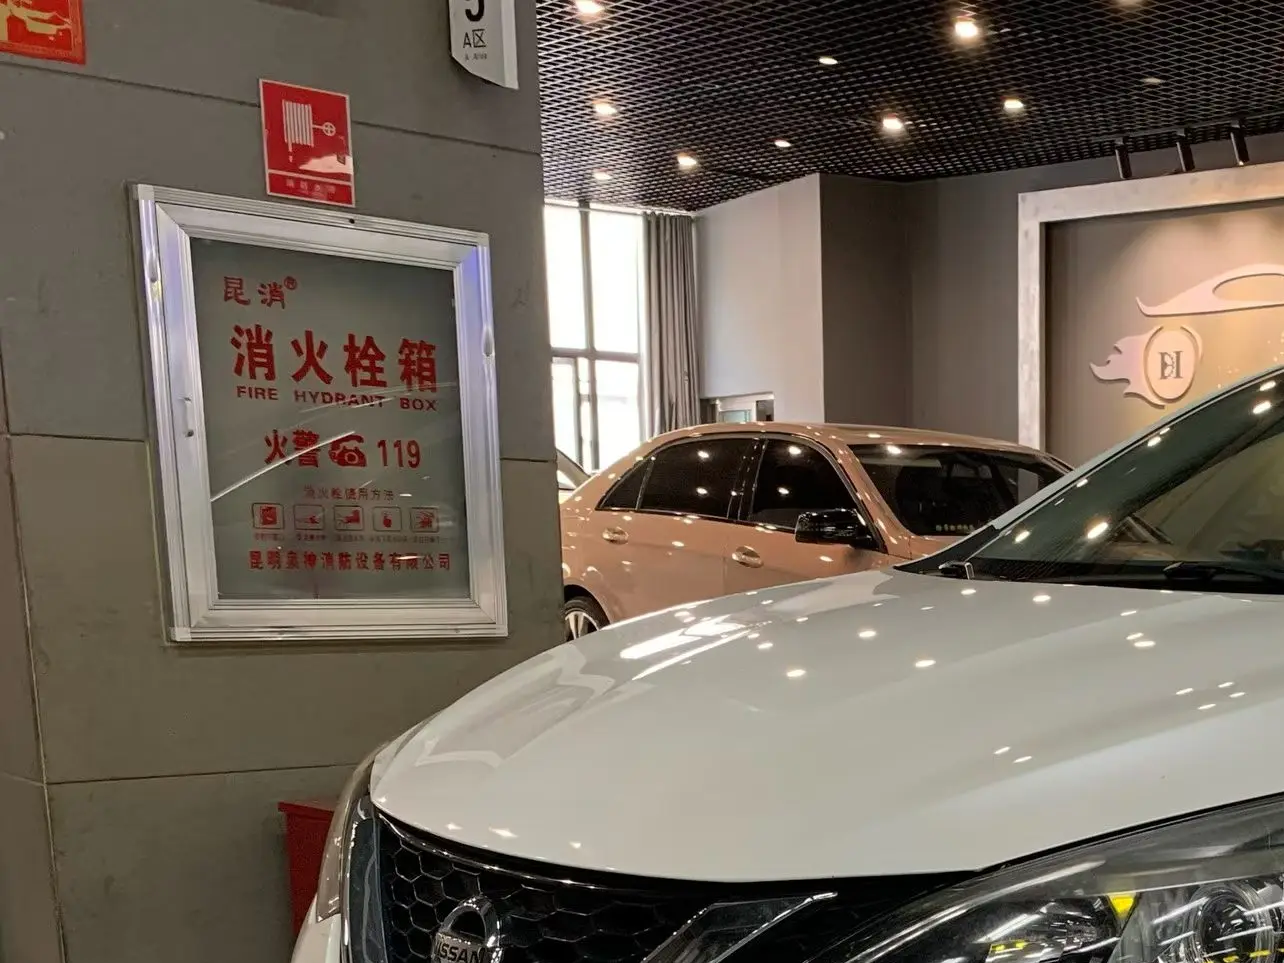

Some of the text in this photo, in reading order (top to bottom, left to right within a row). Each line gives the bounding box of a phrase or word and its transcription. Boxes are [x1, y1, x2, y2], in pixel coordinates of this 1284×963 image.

[230, 323, 438, 393] 消火栓箱
[236, 385, 438, 412] FIRE HYDRANT BOX
[264, 429, 421, 468] 火警 119
